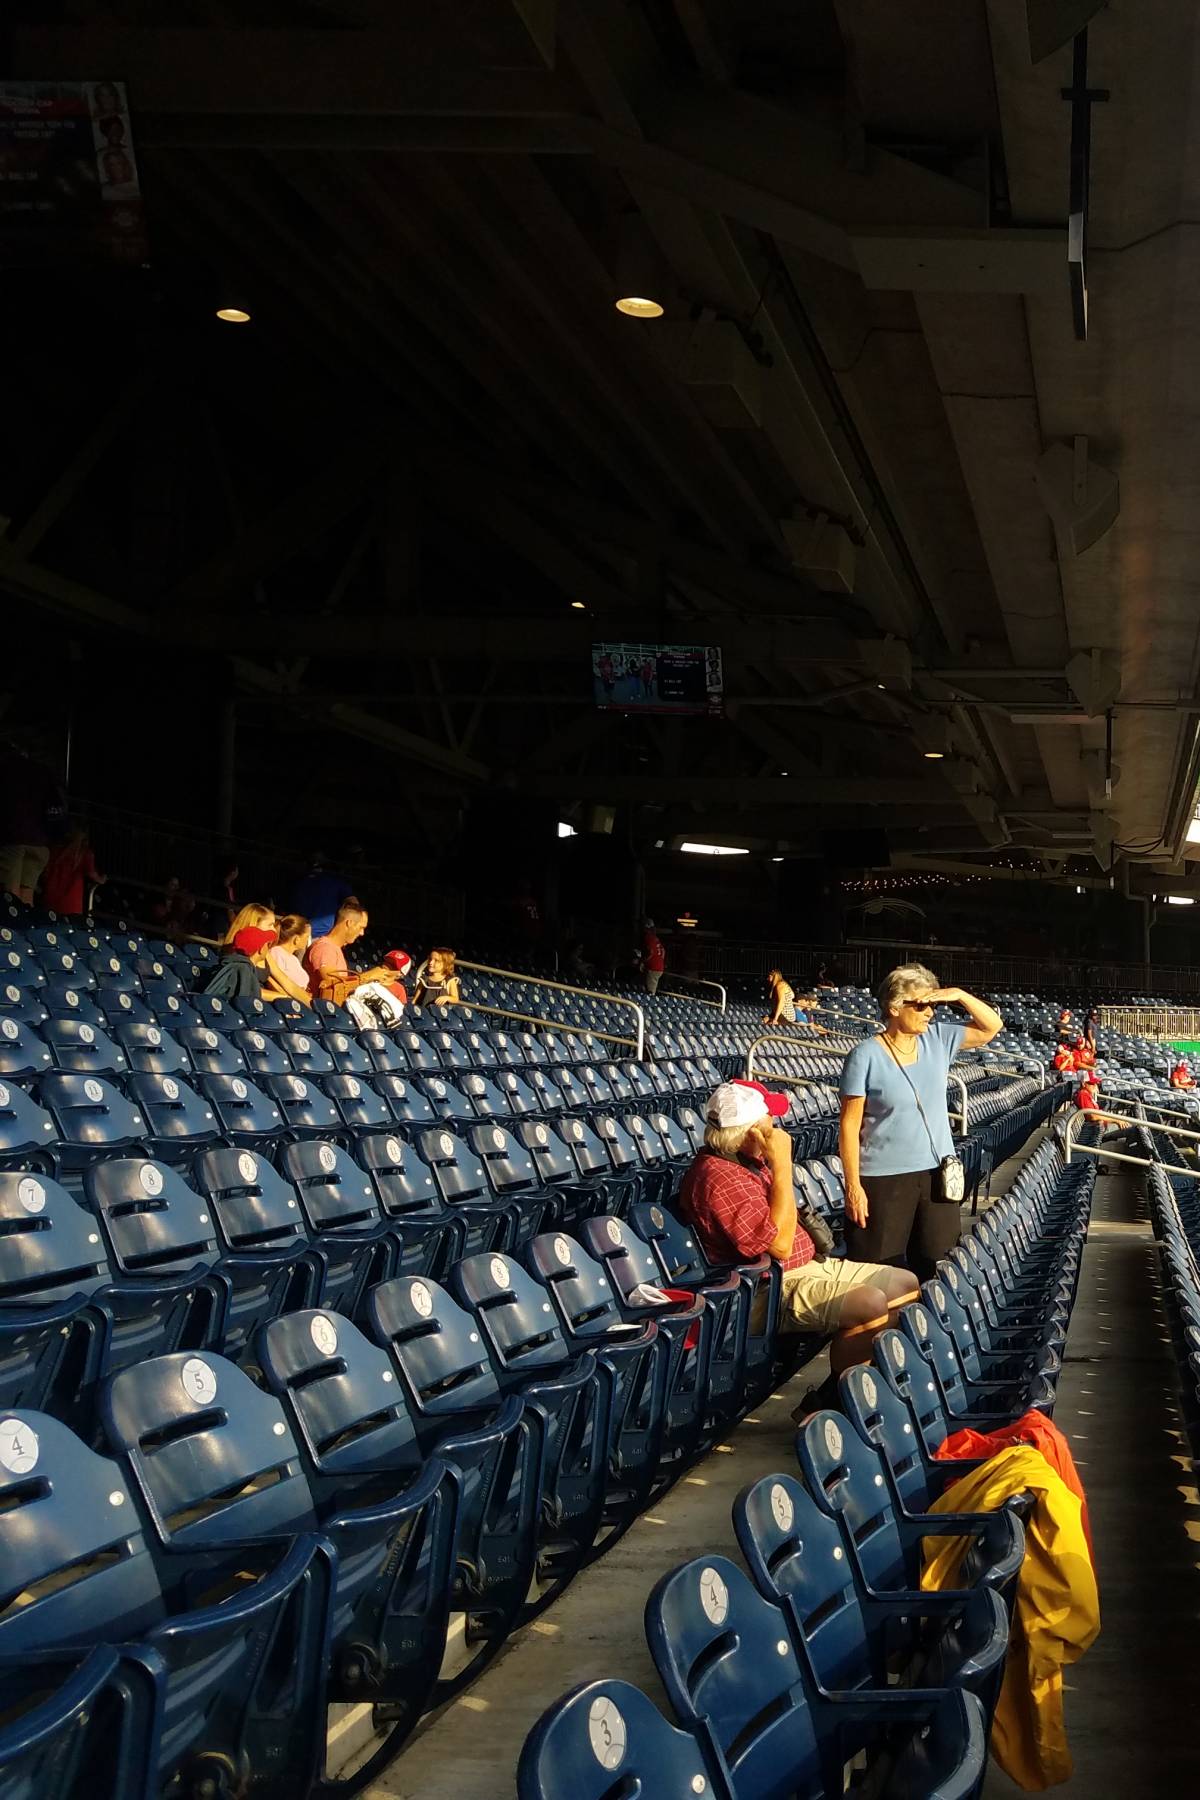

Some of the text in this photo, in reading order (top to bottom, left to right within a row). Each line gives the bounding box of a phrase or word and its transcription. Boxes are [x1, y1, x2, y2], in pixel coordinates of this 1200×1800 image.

[194, 1372, 204, 1391] 5
[12, 1436, 25, 1456] 4
[709, 1585, 719, 1606] 4
[600, 1719, 612, 1746] 3
